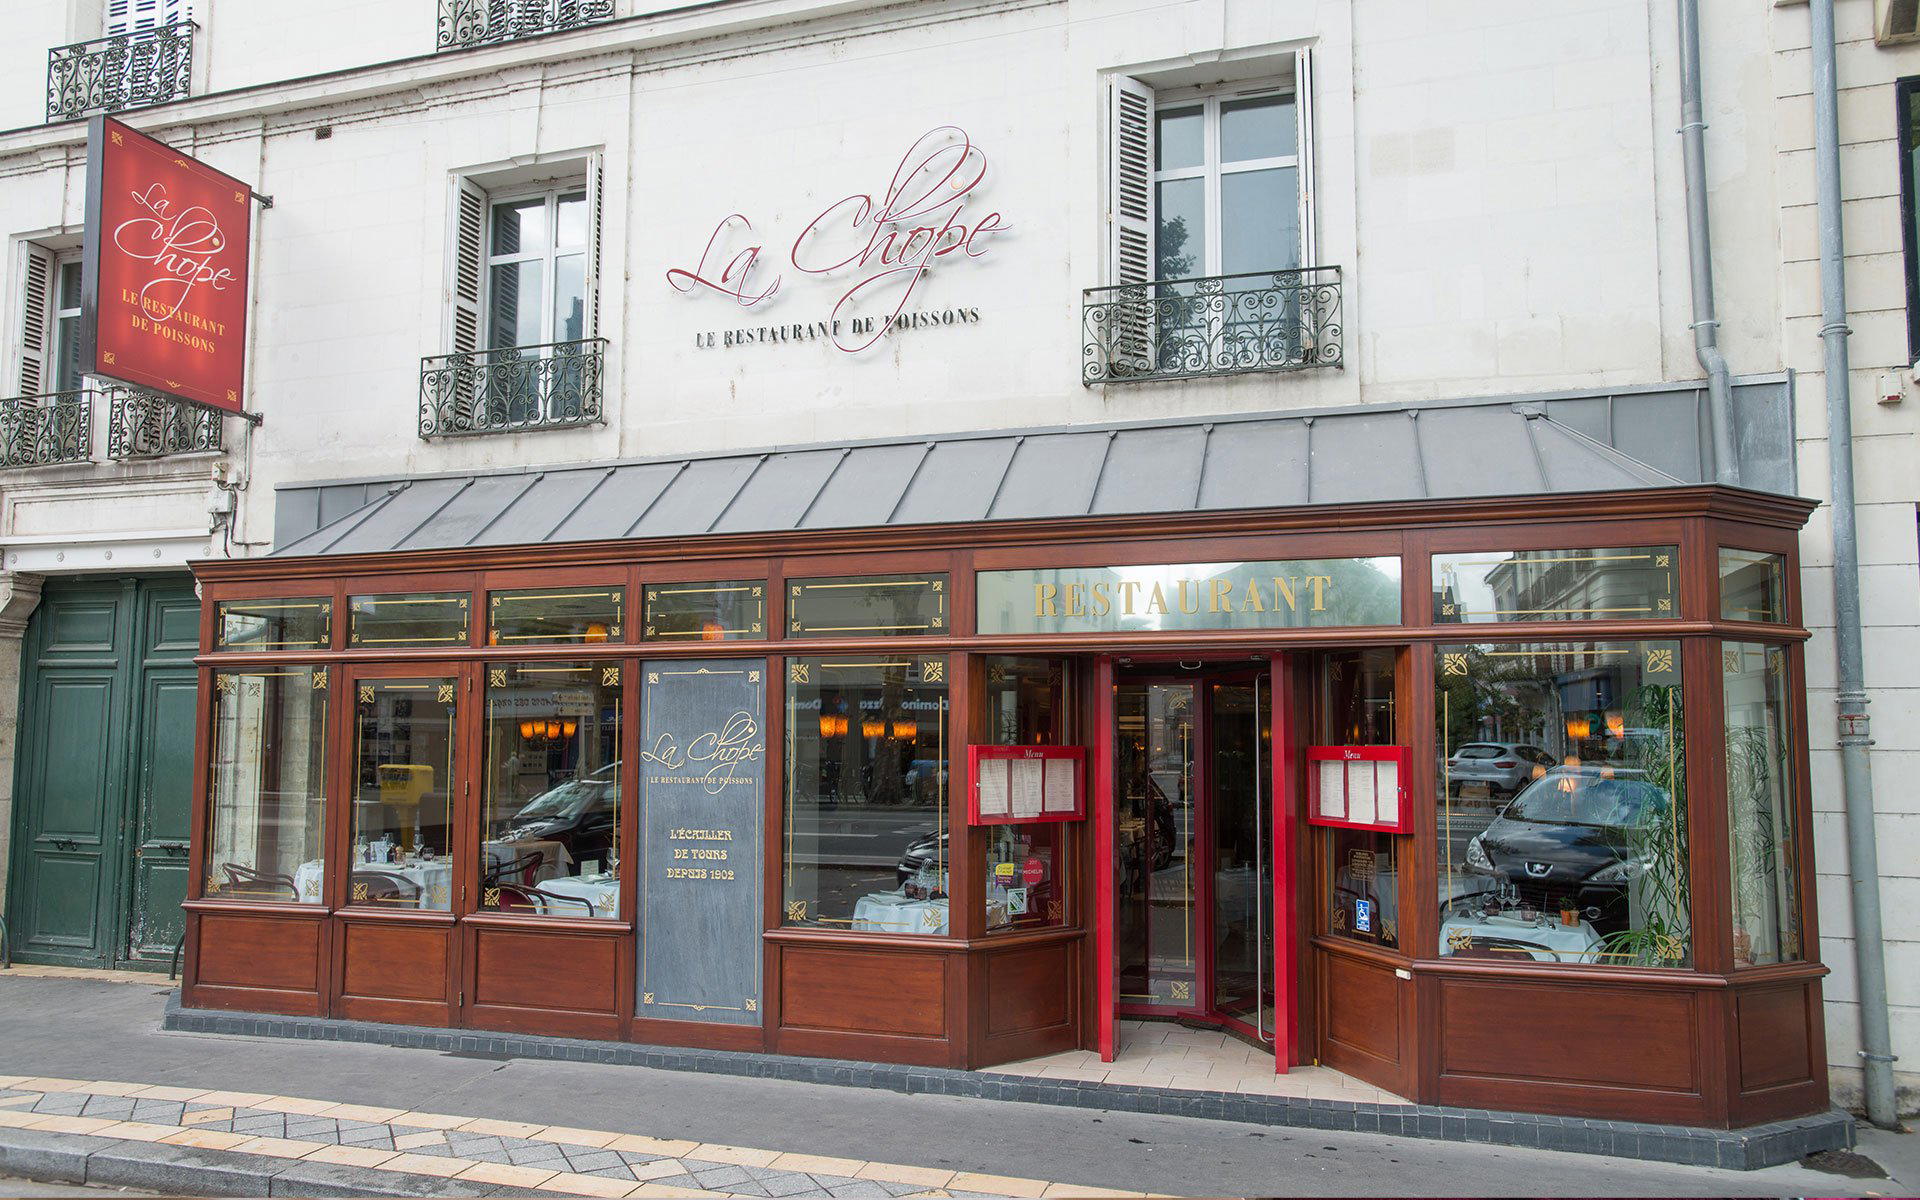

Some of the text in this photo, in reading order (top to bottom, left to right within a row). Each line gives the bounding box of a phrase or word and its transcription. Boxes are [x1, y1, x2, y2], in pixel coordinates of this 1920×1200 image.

[131, 182, 177, 221] La
[666, 125, 1012, 352] La Chope
[114, 206, 236, 322] Chope
[122, 288, 226, 337] LE RESTAURANT
[696, 307, 980, 348] LE RESTAURANT DE POISSONS
[131, 314, 216, 354] DE POISSONS
[1034, 575, 1332, 617] RESTAURANT
[641, 711, 766, 794] La Chope
[1024, 749, 1044, 758] Menu
[1344, 750, 1361, 759] Menu
[669, 827, 733, 841] L'ÉCAILLER
[666, 867, 735, 881] DEPUIS 1902
[674, 848, 728, 861] DE TOURS
